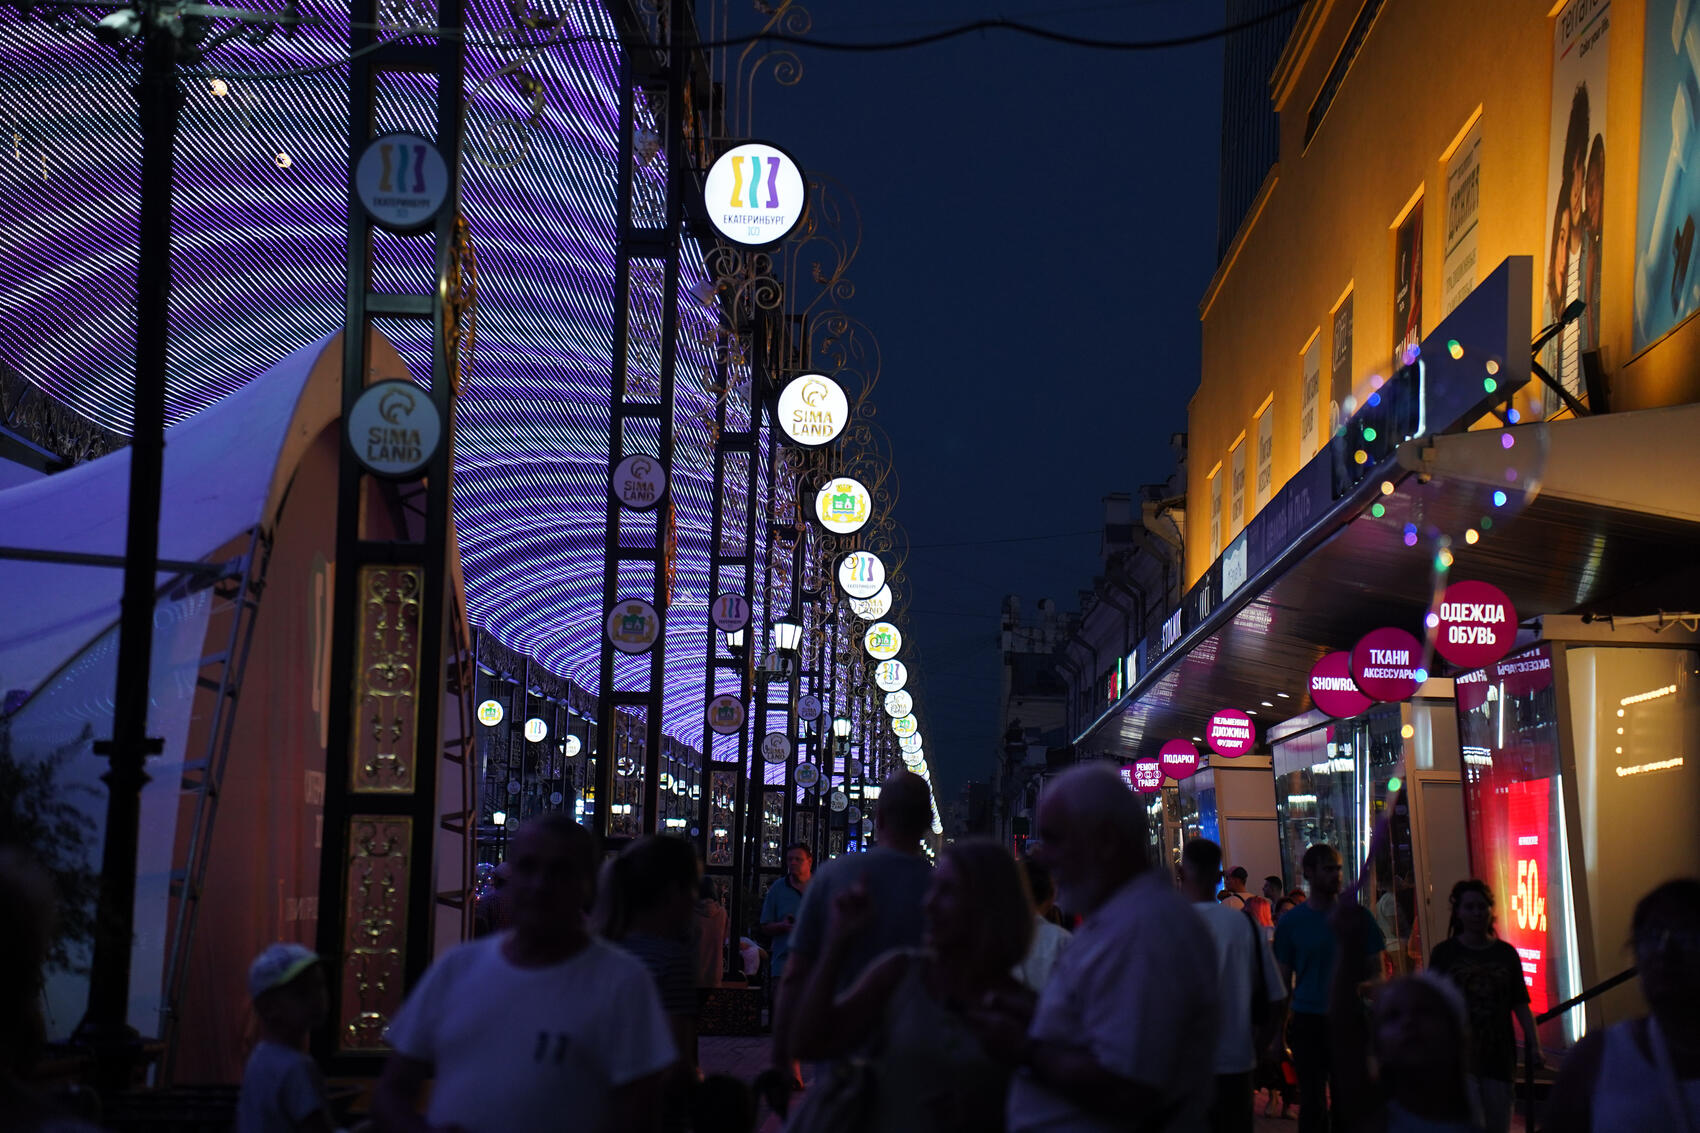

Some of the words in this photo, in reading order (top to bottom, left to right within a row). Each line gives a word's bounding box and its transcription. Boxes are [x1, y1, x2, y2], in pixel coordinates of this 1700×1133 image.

[723, 214, 785, 225] ЕКАТЕРИНБУРГ
[793, 409, 833, 424] SIMA
[368, 426, 421, 446] SIMA
[792, 423, 834, 437] LAND
[367, 444, 422, 463] LAND
[623, 480, 655, 492] SIMA
[623, 490, 656, 502] LAND
[1440, 602, 1506, 624] ОДЕЖДА
[1448, 625, 1496, 645] ОБУВЬ
[1369, 649, 1410, 666] ТКАНИ
[1363, 667, 1417, 680] АКСЕССУАРЫ
[1211, 726, 1250, 739] ДЮЖИНА
[1216, 738, 1244, 748] ФУДКОРТ
[1163, 754, 1195, 764] ПОДАРКИ
[1136, 763, 1159, 771] РЕМОНТ
[1137, 778, 1159, 787] ГРАВЕР
[1511, 859, 1547, 931] -50%
